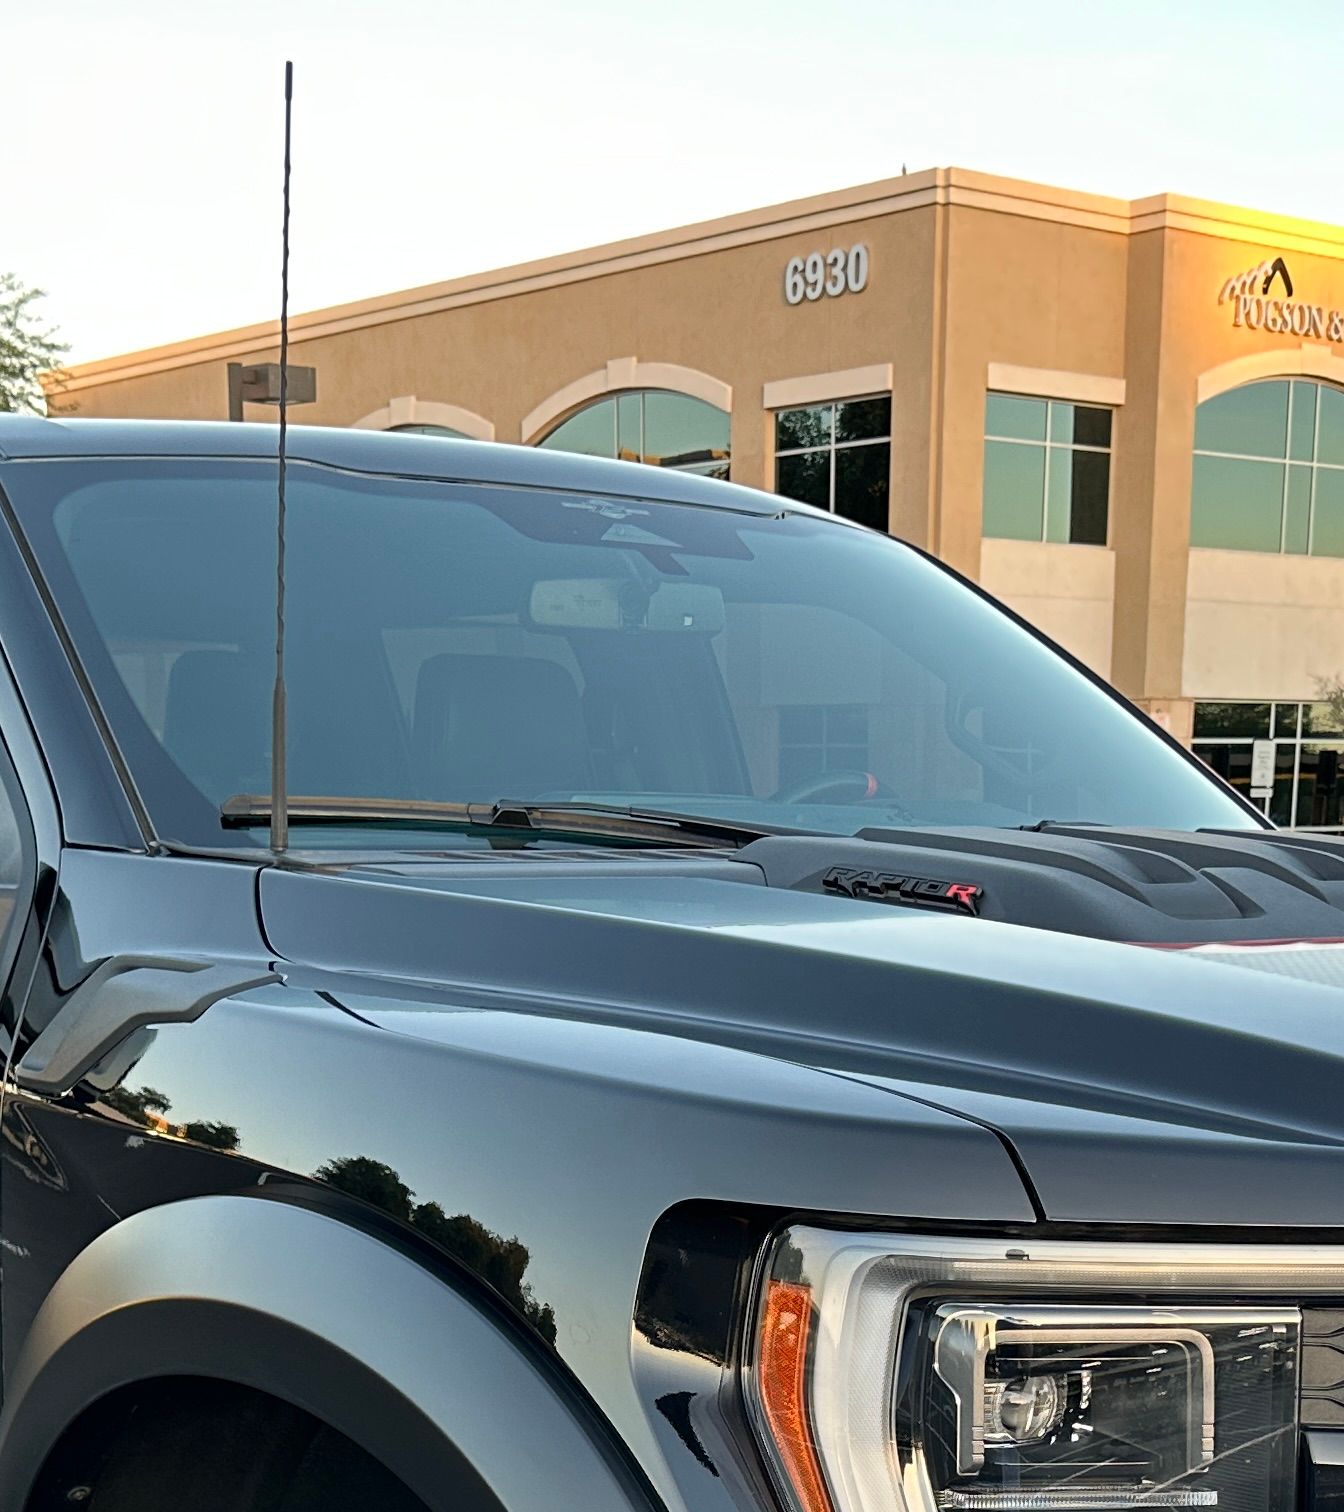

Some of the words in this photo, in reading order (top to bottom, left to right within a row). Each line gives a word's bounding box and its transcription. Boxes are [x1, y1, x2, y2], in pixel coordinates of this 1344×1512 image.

[785, 244, 869, 306] 6930
[1233, 294, 1325, 339] POGSON
[822, 865, 984, 917] RAPTOR
